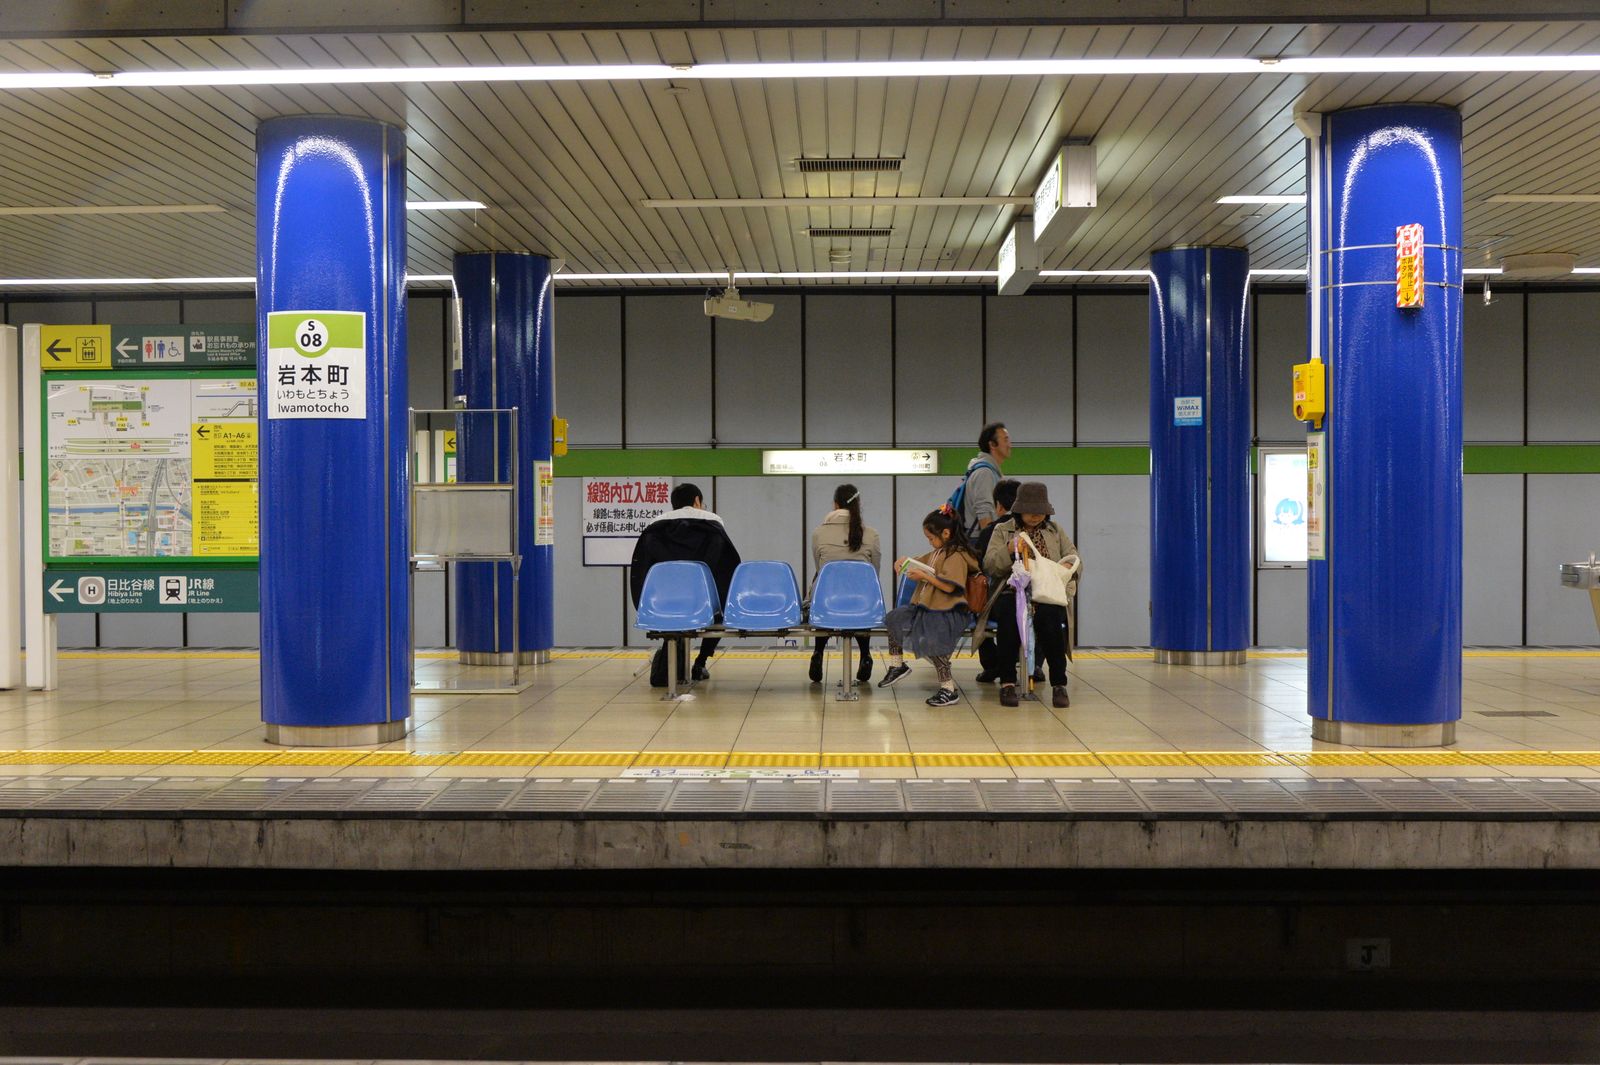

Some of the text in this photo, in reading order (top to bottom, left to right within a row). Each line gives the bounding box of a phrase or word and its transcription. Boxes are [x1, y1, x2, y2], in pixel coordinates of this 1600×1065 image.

[307, 320, 315, 331] S
[300, 333, 322, 347] 08
[278, 364, 350, 386] 岩本町
[277, 389, 350, 400] いわもとちょう
[277, 402, 350, 413] Iwamotocho
[833, 452, 867, 462] 岩本町
[586, 481, 669, 504] 線路内立入厳禁
[586, 522, 651, 533] 必ず係員にお申し出
[107, 578, 215, 591] 日比谷線 JR線
[88, 586, 95, 595] H
